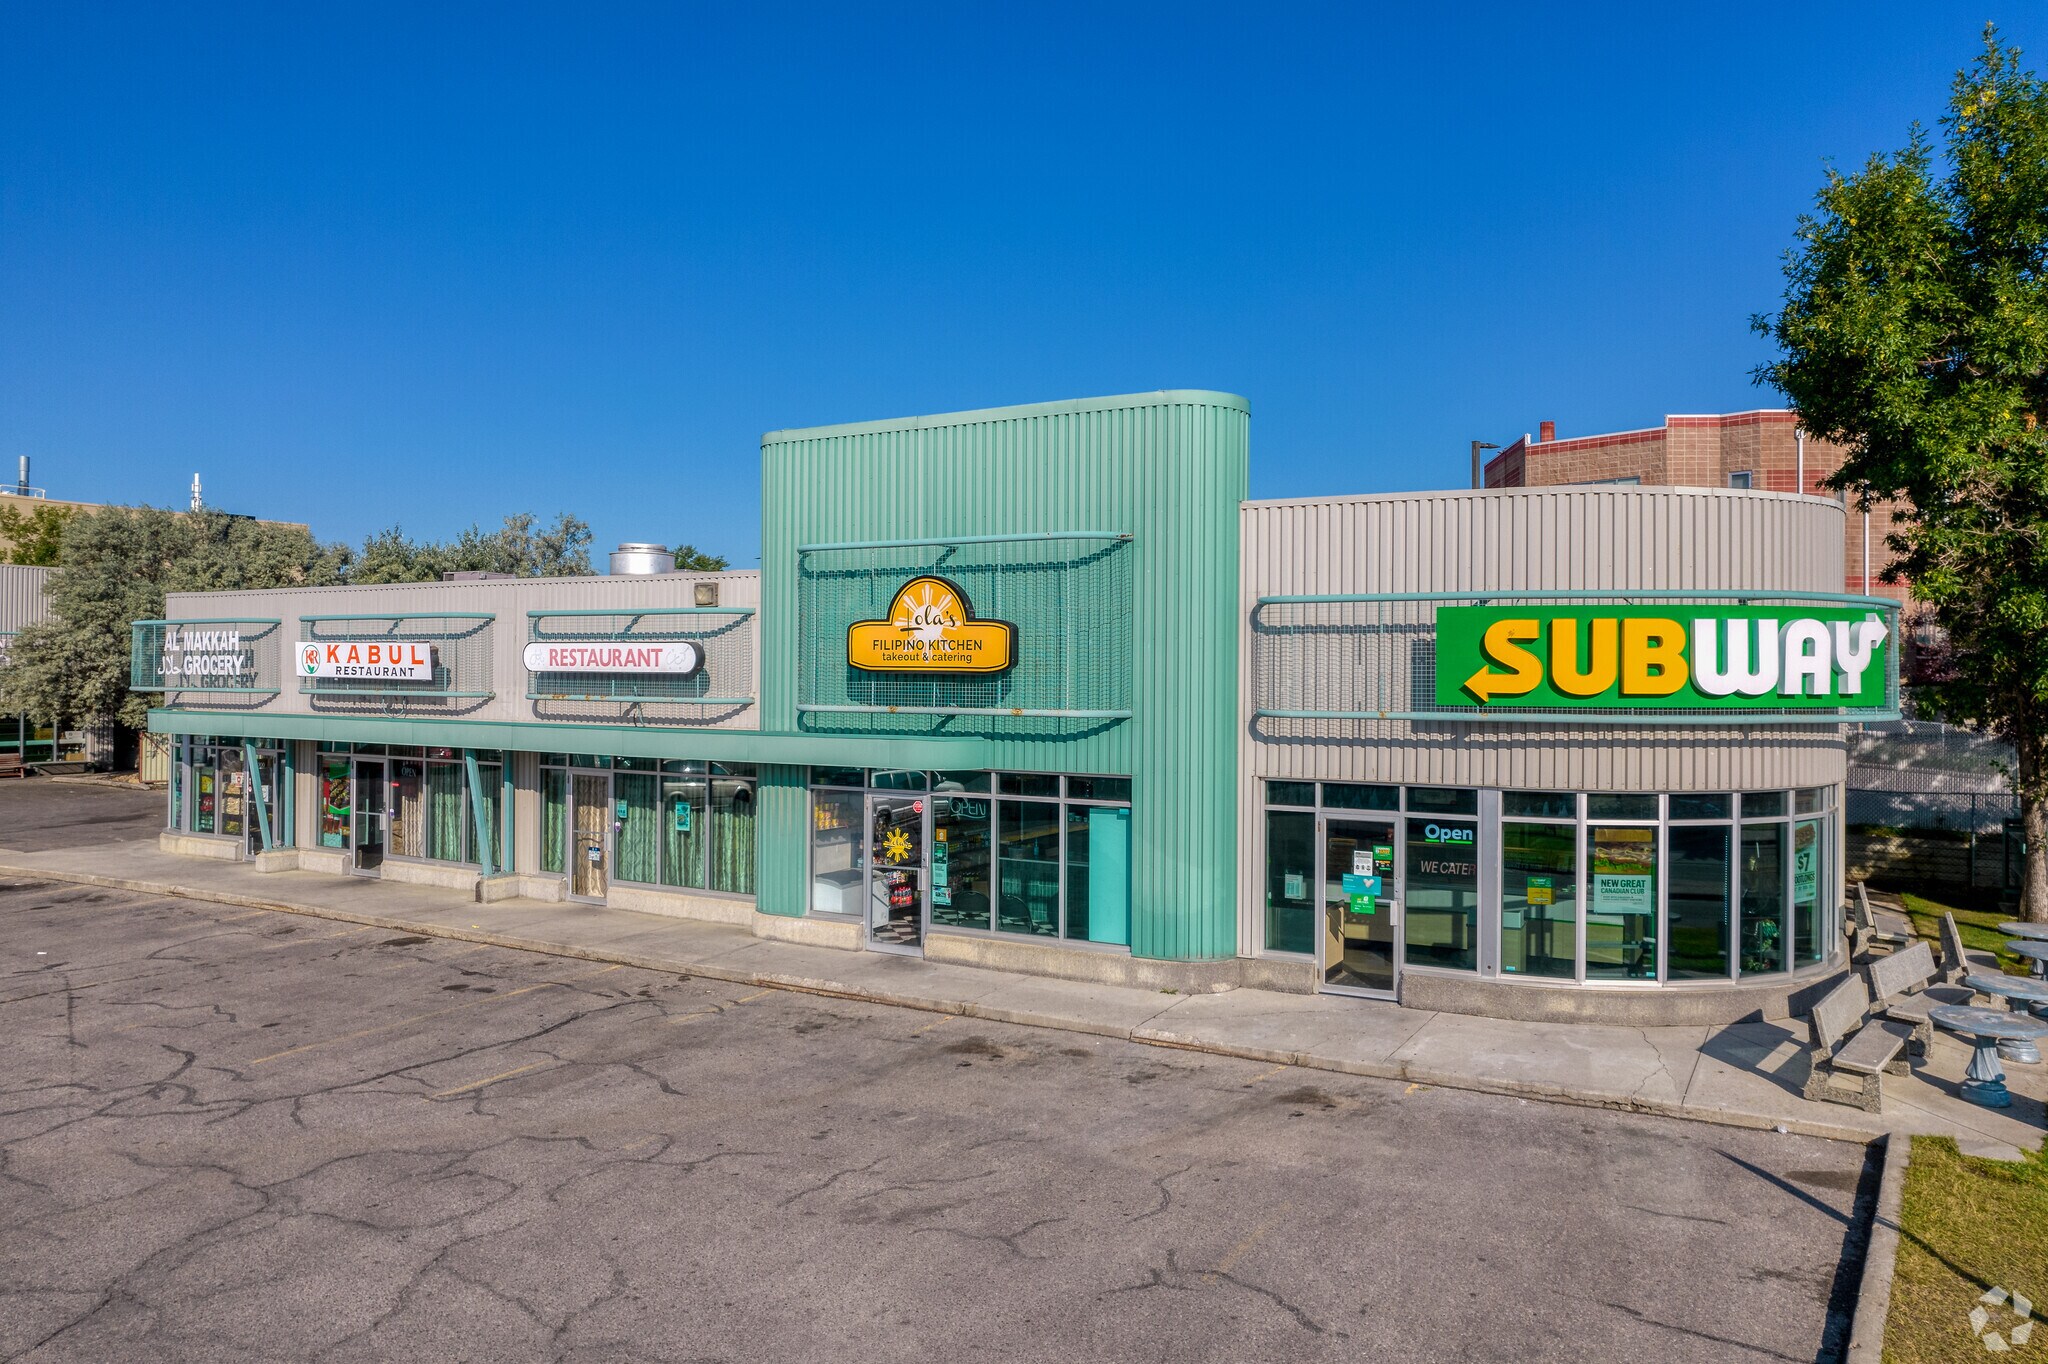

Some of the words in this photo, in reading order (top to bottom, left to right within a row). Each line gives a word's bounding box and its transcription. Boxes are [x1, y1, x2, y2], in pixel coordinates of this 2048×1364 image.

[900, 604, 956, 636] Lola's
[164, 632, 179, 651] AL
[183, 630, 239, 651] MAKKAH
[872, 639, 925, 651] FILIPINO
[928, 639, 983, 651] KITCHEN
[326, 644, 424, 665] KABUL
[549, 648, 663, 667] RESTAURANT
[882, 652, 920, 661] takeout
[922, 652, 929, 662] &
[932, 653, 972, 664] catering
[1464, 613, 1889, 702] SUBWAY
[183, 655, 244, 675] GROCERY
[335, 666, 415, 677] RESTAURANT
[402, 766, 417, 777] OPEN
[950, 799, 986, 816] OPEN
[1425, 824, 1473, 843] Open
[1420, 860, 1439, 873] WE
[1440, 862, 1476, 876] CATER
[1797, 853, 1810, 871] $7
[1601, 879, 1619, 888] NEW
[1620, 880, 1646, 888] GREAT
